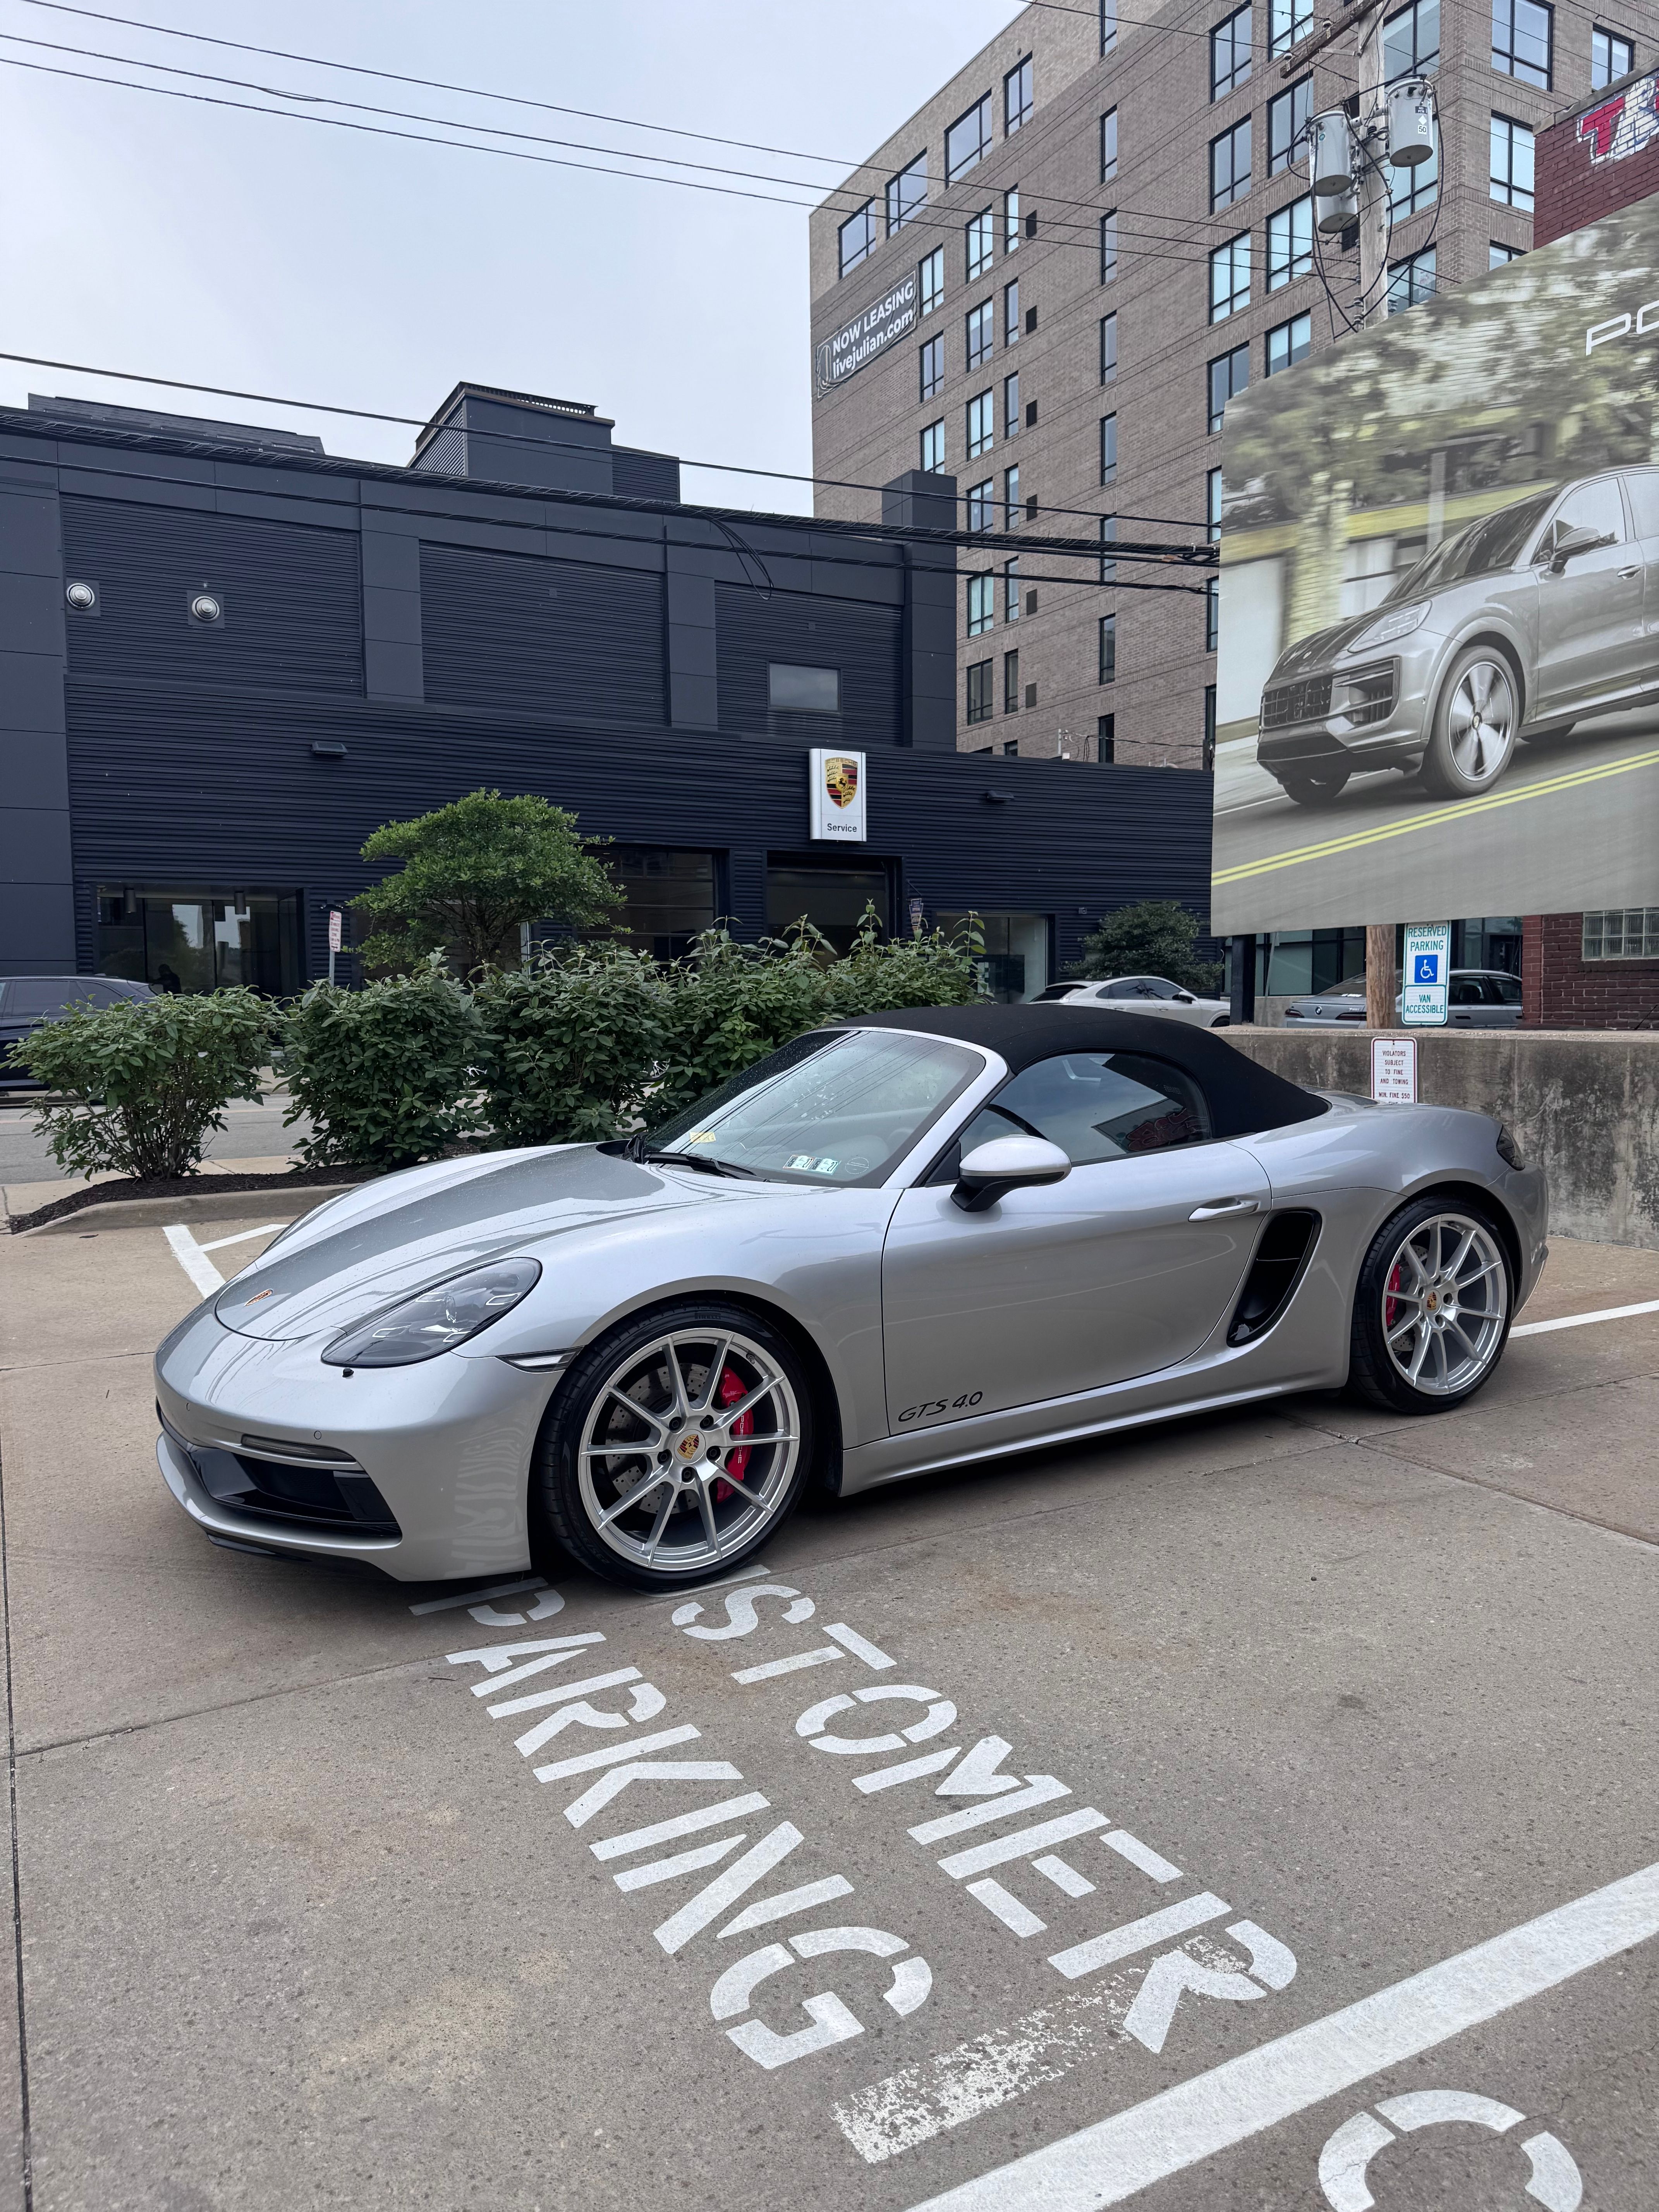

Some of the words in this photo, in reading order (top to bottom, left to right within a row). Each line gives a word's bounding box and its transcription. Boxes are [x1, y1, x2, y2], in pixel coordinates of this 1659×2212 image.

[833, 321, 861, 357] NOW
[864, 282, 914, 333] LEASING
[833, 309, 913, 379] livejulian.com
[827, 823, 857, 832] Service
[1408, 926, 1446, 937] RESERVED
[1410, 940, 1444, 951] PARKING
[1419, 994, 1431, 1003] VAN
[1405, 1005, 1444, 1013] ACCESSIBLE
[827, 1162, 838, 1172] 27
[898, 1399, 949, 1422] GTS
[952, 1391, 983, 1409] 4.0
[409, 1577, 933, 2069] PARKING
